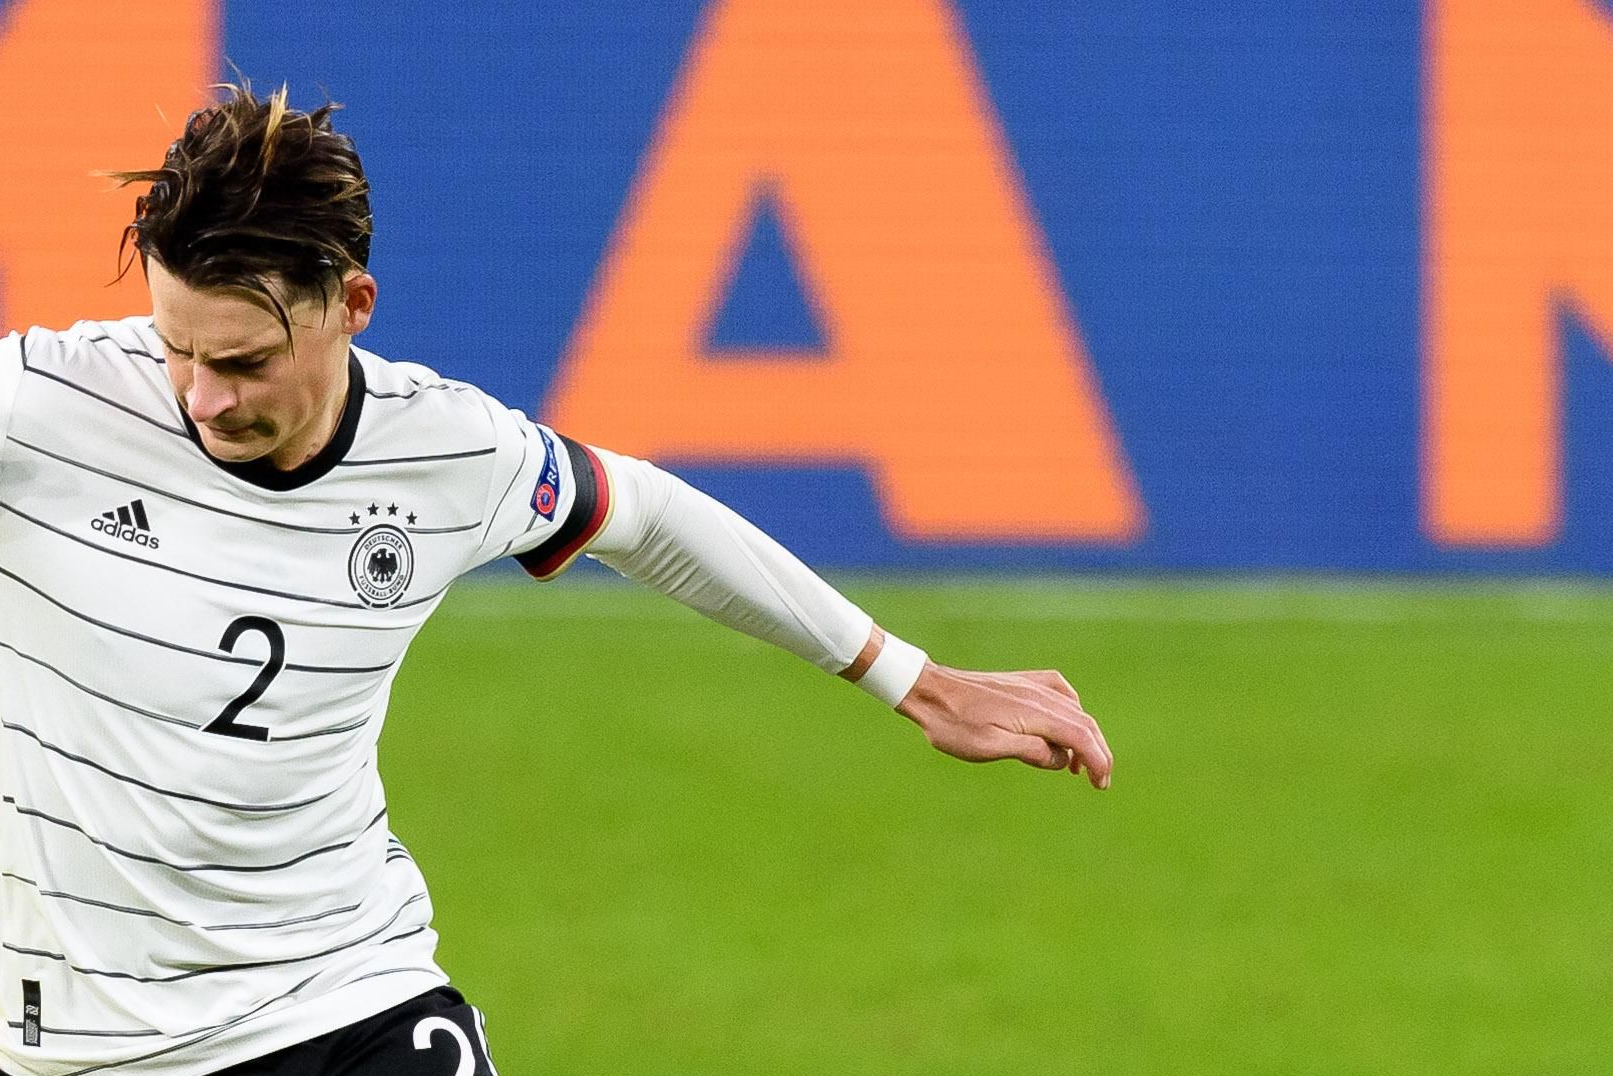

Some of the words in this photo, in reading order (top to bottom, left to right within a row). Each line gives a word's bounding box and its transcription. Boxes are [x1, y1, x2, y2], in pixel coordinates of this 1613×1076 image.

[90, 518, 160, 550] adidas
[364, 535, 403, 550] DEUTSCHER
[201, 615, 285, 742] 2
